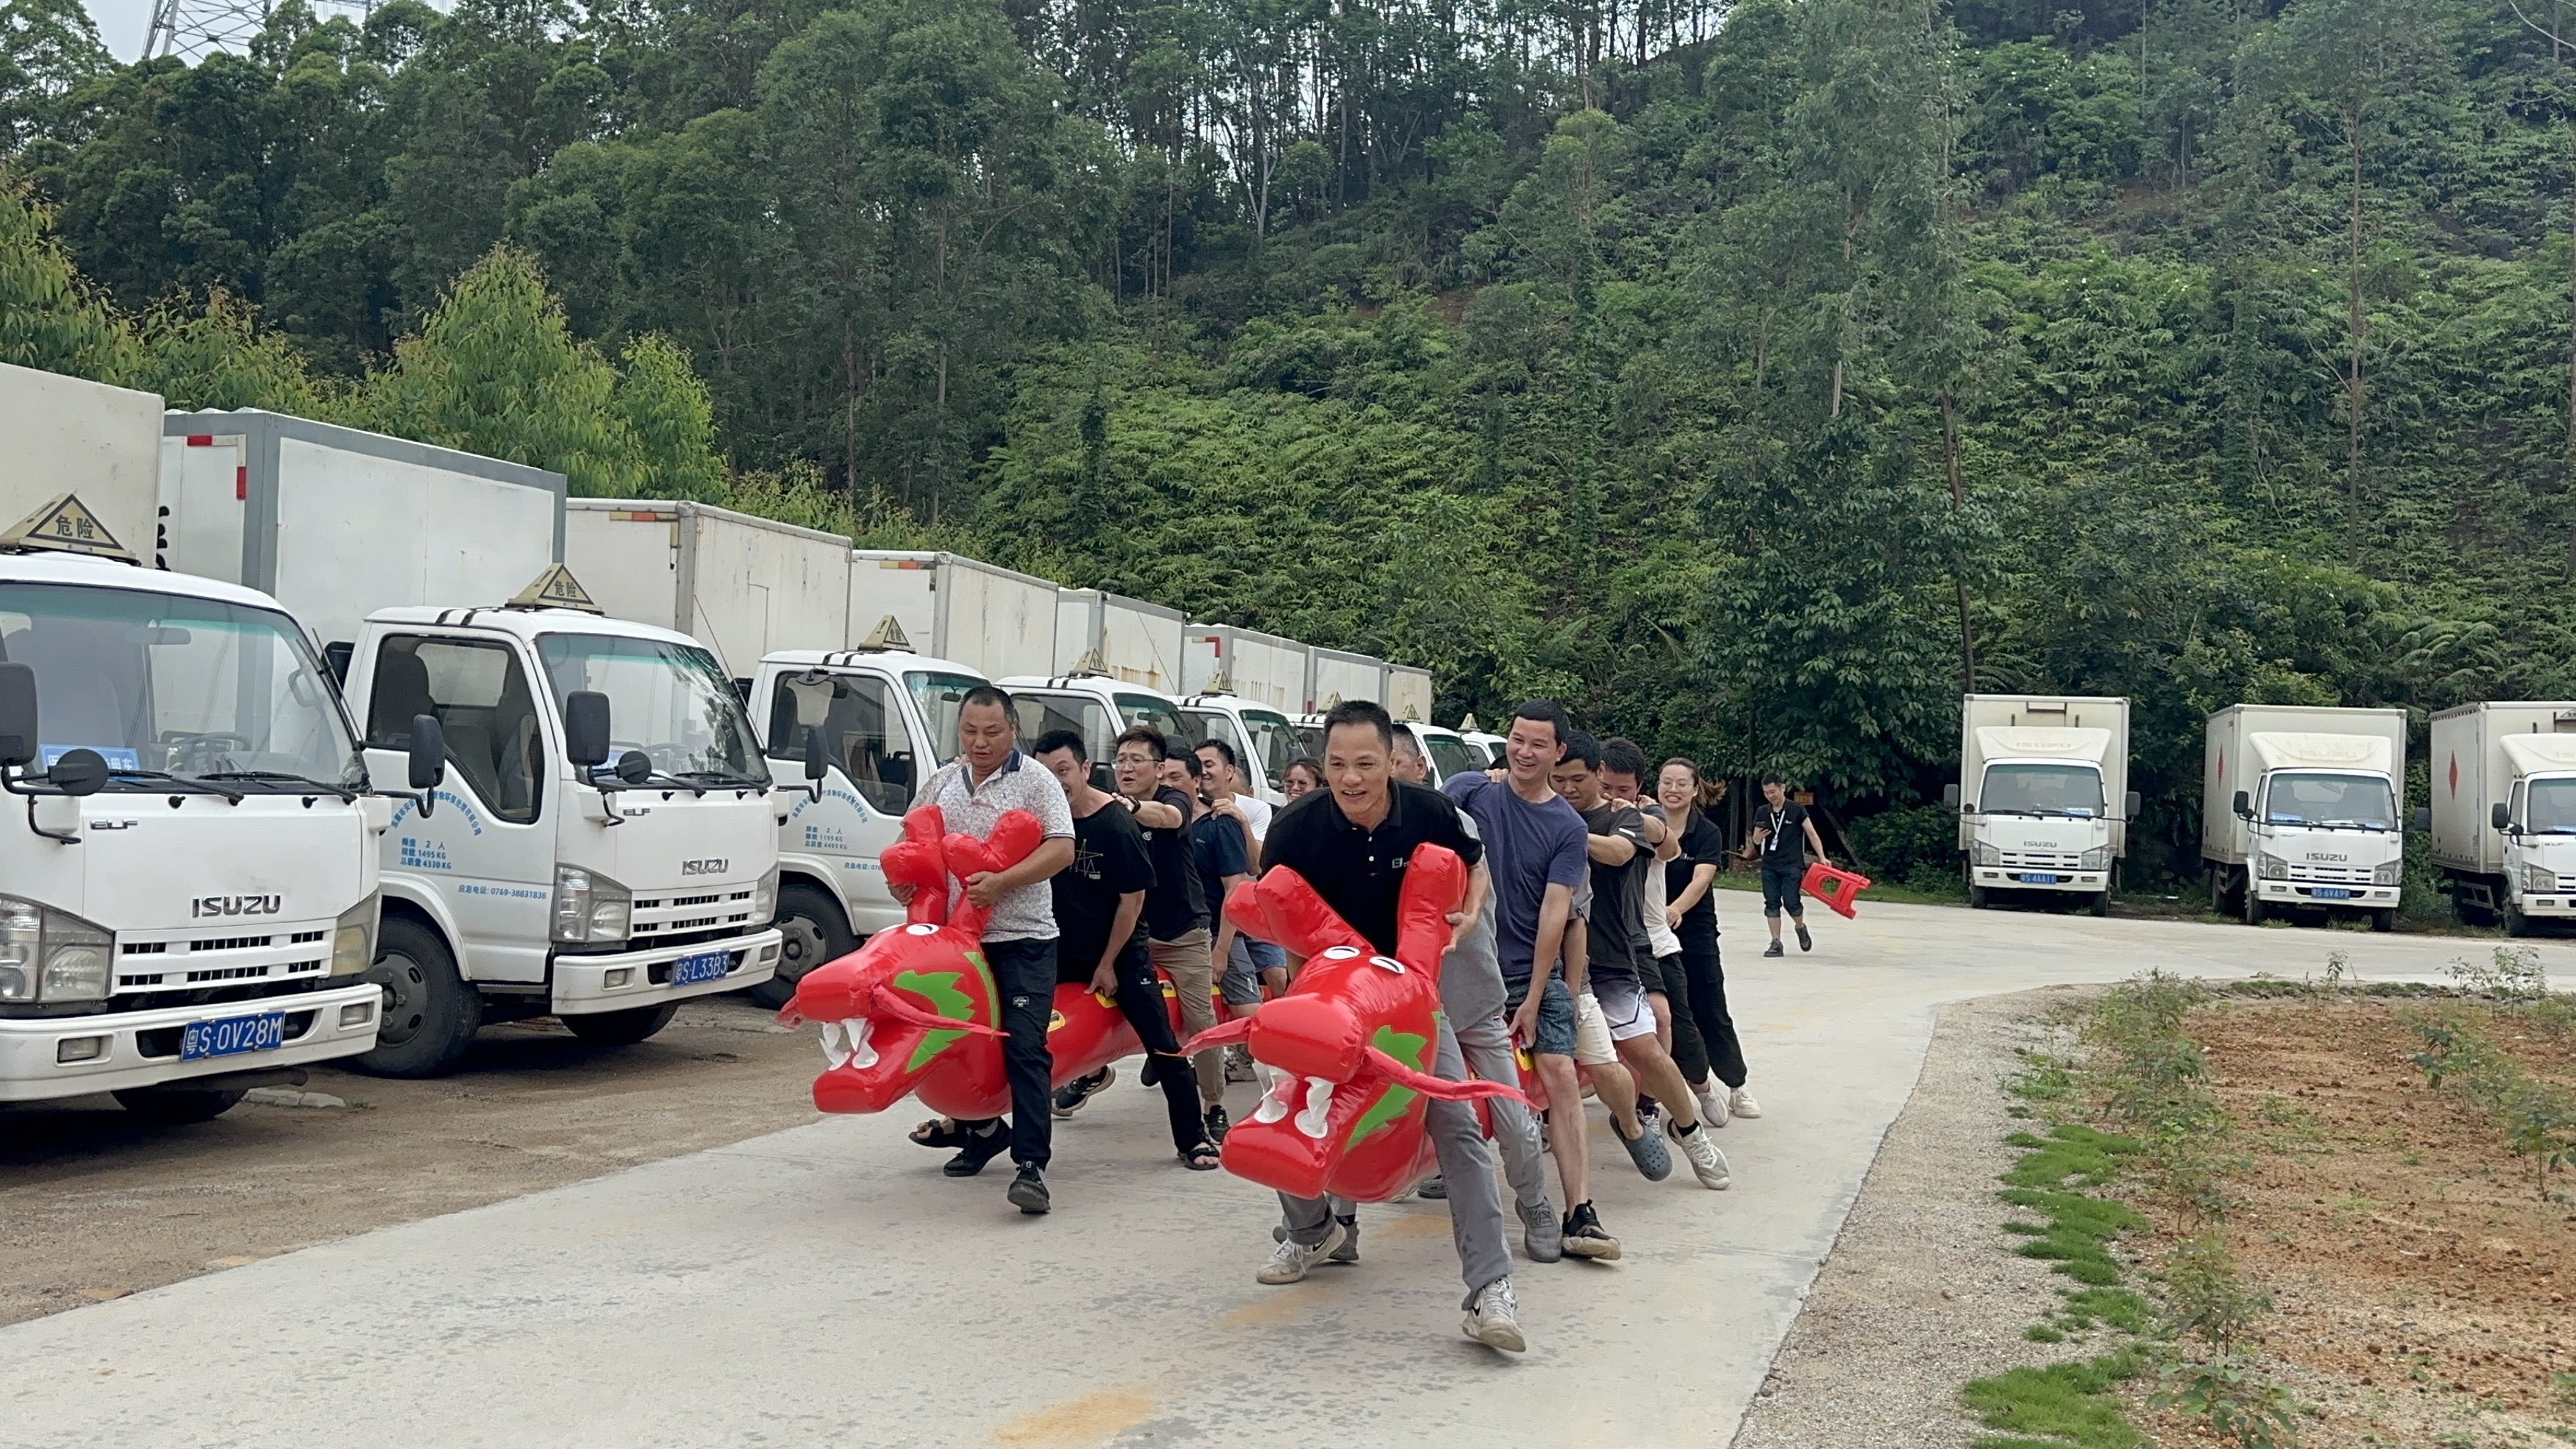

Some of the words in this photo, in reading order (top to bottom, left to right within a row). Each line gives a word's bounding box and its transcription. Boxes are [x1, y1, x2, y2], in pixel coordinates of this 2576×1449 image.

[56, 514, 94, 539] 危险
[554, 580, 577, 598] 危险
[623, 808, 651, 816] ELF
[425, 840, 431, 848] 2
[438, 842, 445, 850] 人
[418, 850, 435, 858] 1495
[2306, 852, 2347, 862] ISUZU
[682, 858, 729, 876] ISUZU
[192, 894, 281, 918] ISUZU
